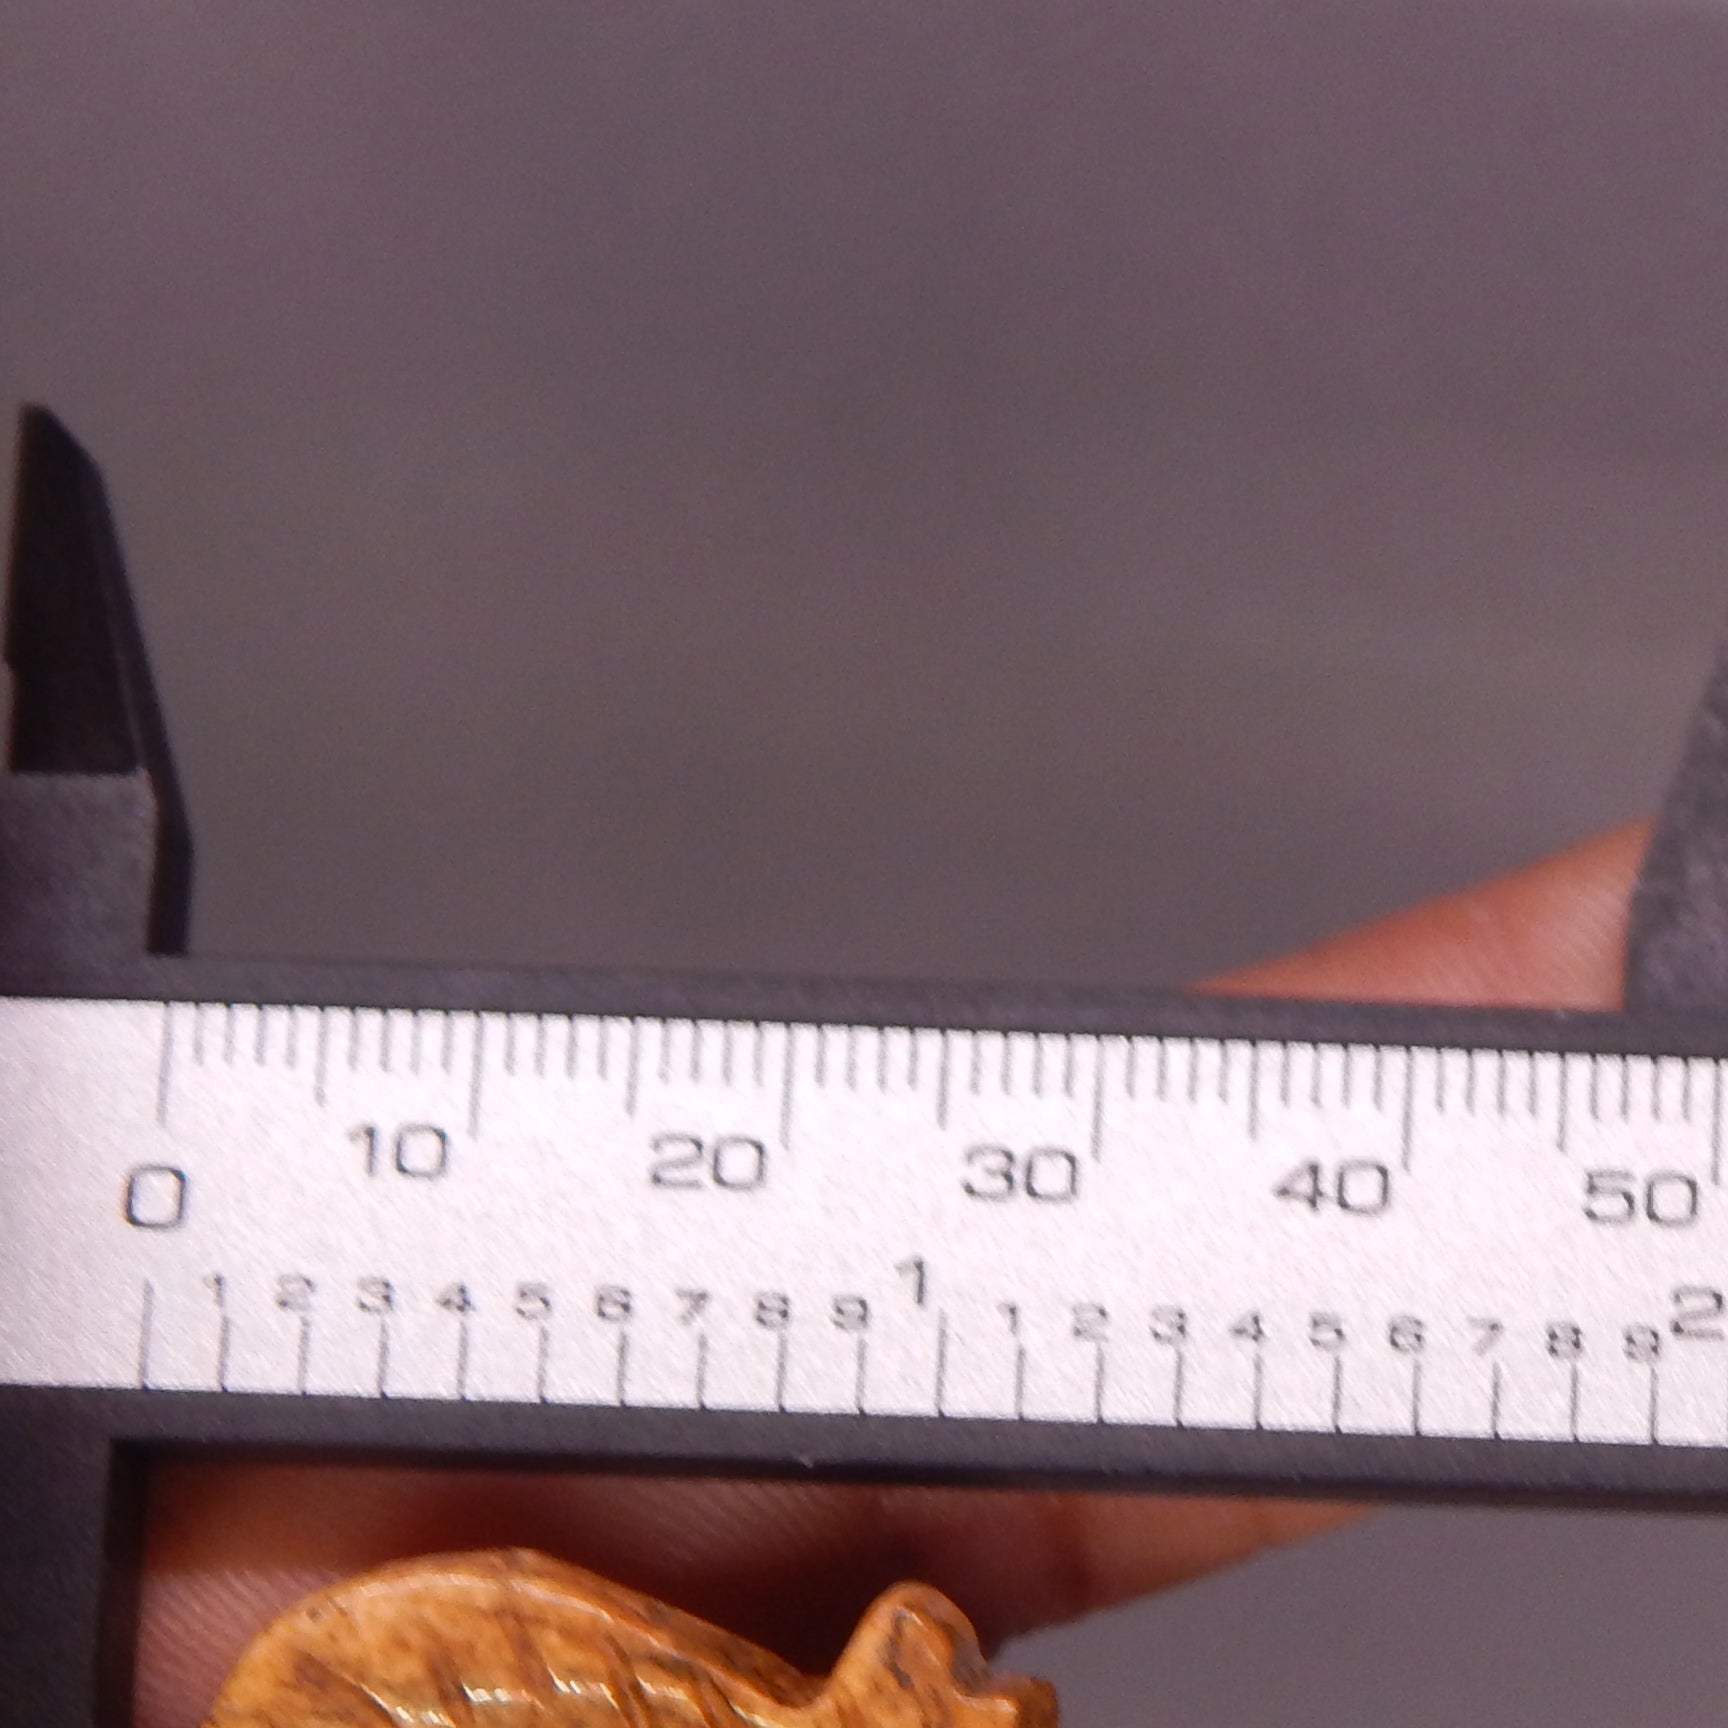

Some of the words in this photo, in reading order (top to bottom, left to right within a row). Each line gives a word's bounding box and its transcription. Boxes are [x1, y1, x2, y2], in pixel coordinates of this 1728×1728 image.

[125, 1165, 187, 1230] 0
[345, 1124, 450, 1179] 10
[650, 1134, 767, 1191] 20
[961, 1146, 1079, 1203] 30
[1273, 1160, 1392, 1215] 40
[1583, 1170, 1701, 1227] 50
[277, 1277, 318, 1309] 2
[356, 1278, 395, 1313] 3
[435, 1282, 475, 1314] 4
[514, 1283, 553, 1320] 5
[674, 1291, 710, 1326] 7
[753, 1294, 791, 1328] 8
[832, 1295, 870, 1332] 9
[894, 1257, 930, 1306] 1
[1069, 1306, 1108, 1340] 2
[1148, 1308, 1189, 1342] 3
[1229, 1311, 1266, 1345] 4
[1308, 1313, 1347, 1347] 5
[1387, 1316, 1426, 1352] 6
[1468, 1320, 1505, 1356] 7
[1670, 1287, 1727, 1340] 2
